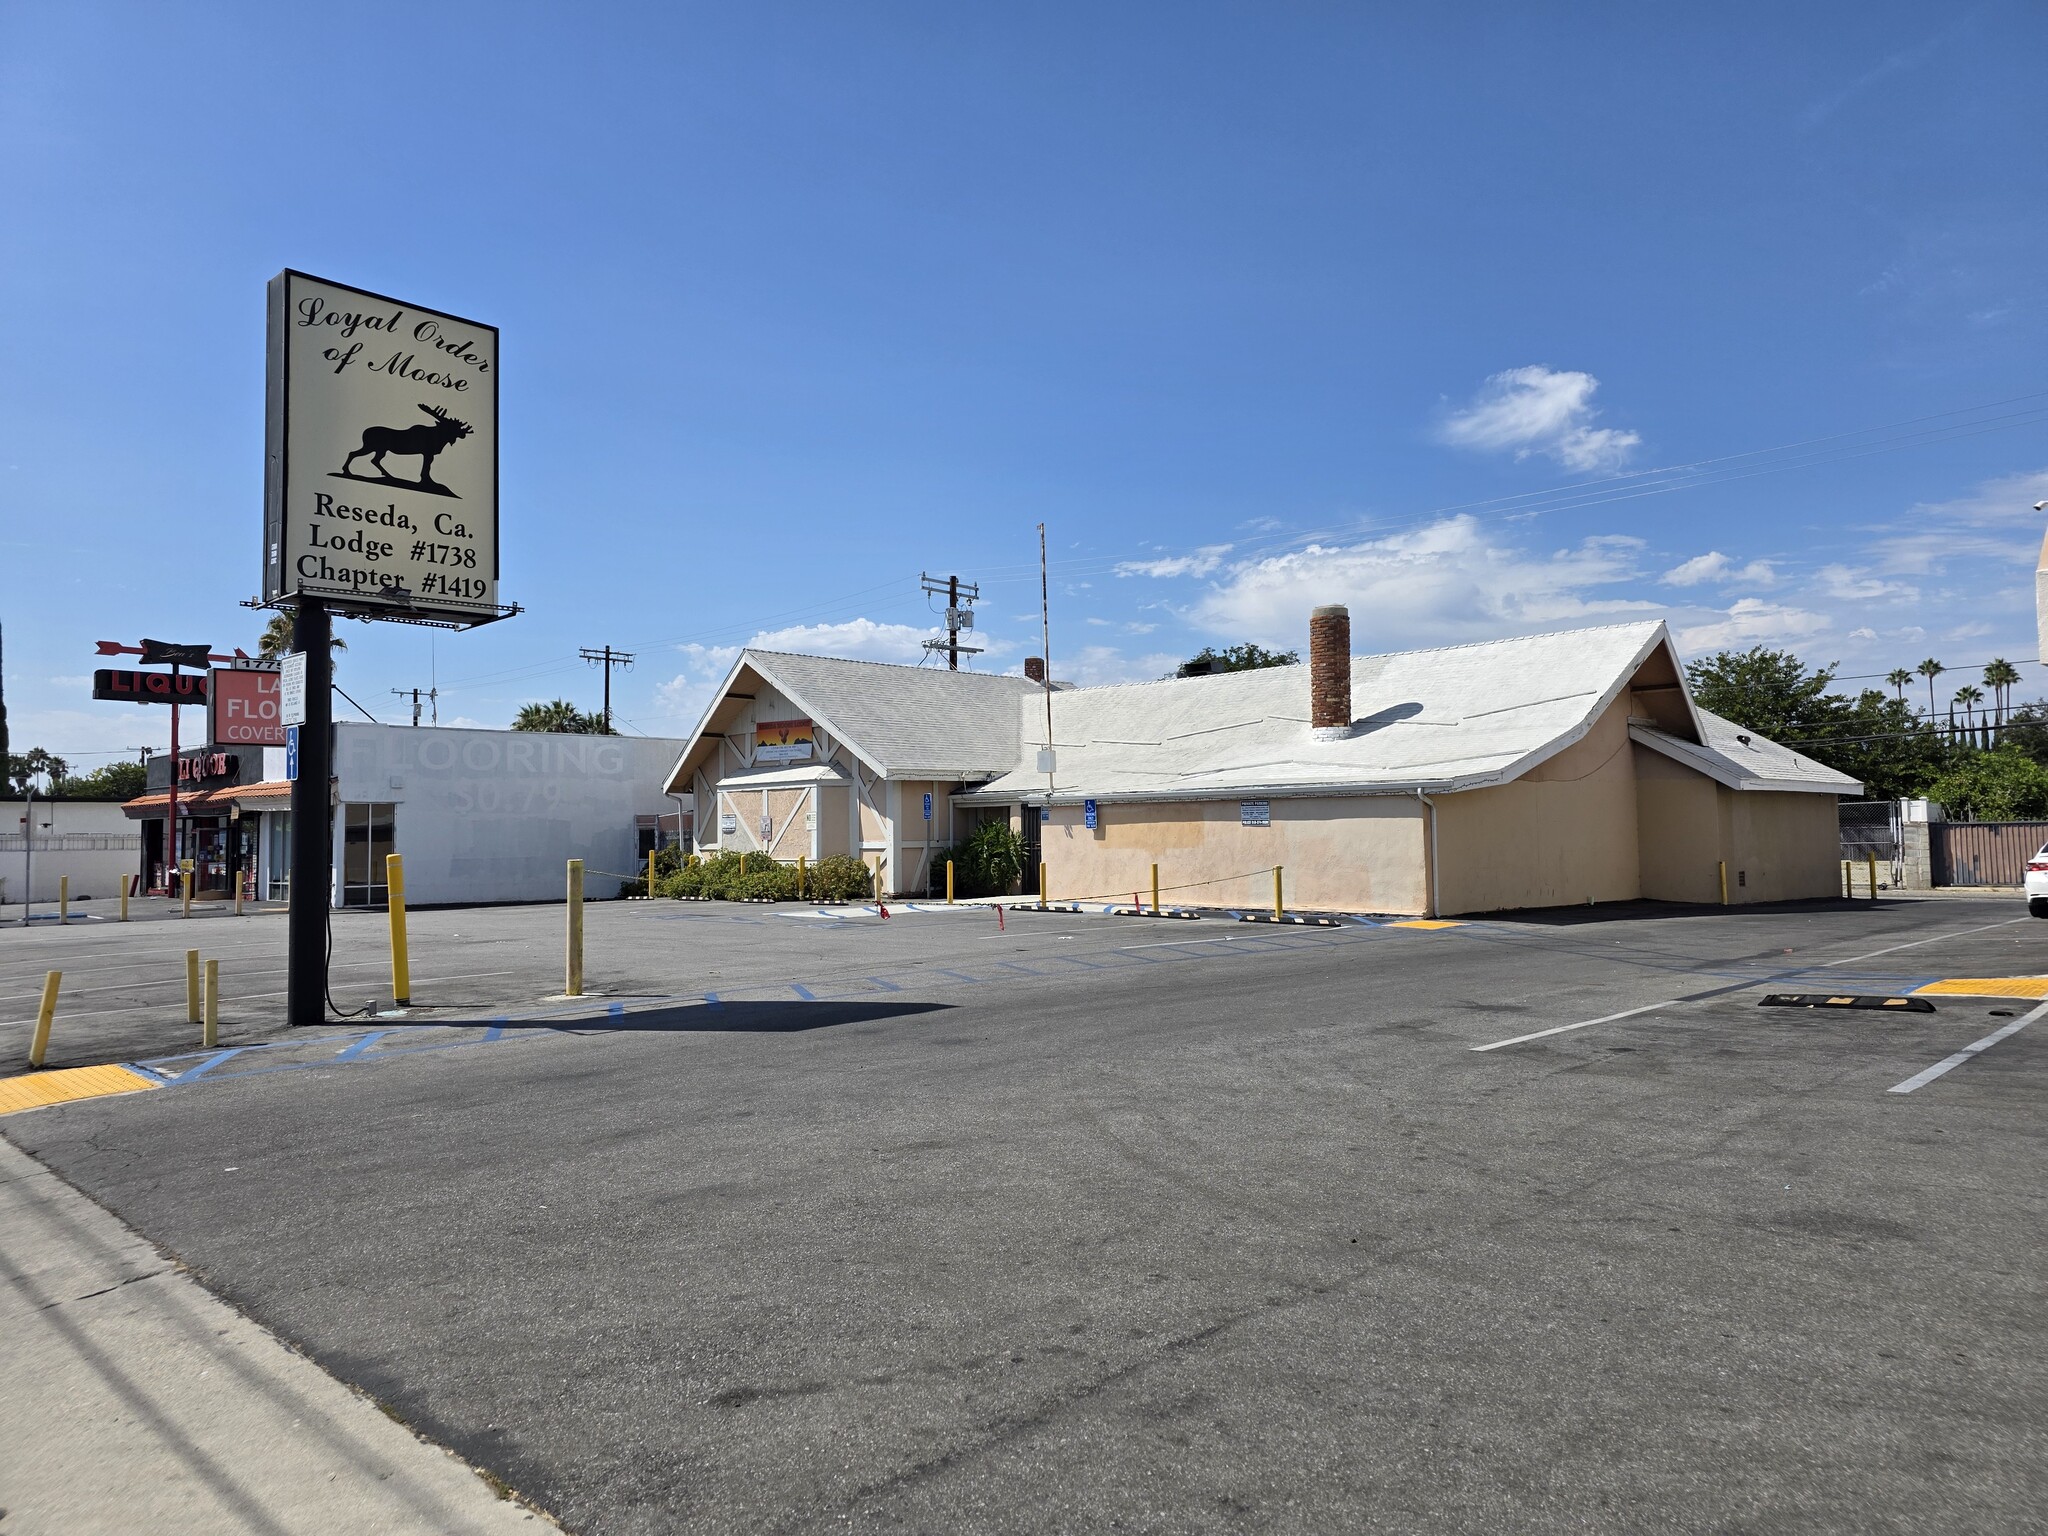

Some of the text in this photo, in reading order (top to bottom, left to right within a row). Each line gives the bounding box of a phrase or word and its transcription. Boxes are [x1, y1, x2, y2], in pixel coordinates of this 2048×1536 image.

[298, 297, 490, 373] Loyal Order
[322, 342, 470, 393] of Moose
[314, 492, 474, 540] Reseda, Ca.
[309, 523, 394, 561] Lodge
[410, 540, 477, 569] #1738
[296, 554, 405, 591] Chapter
[421, 572, 487, 600] #1419
[227, 698, 281, 719] FLO
[227, 725, 286, 741] COVER
